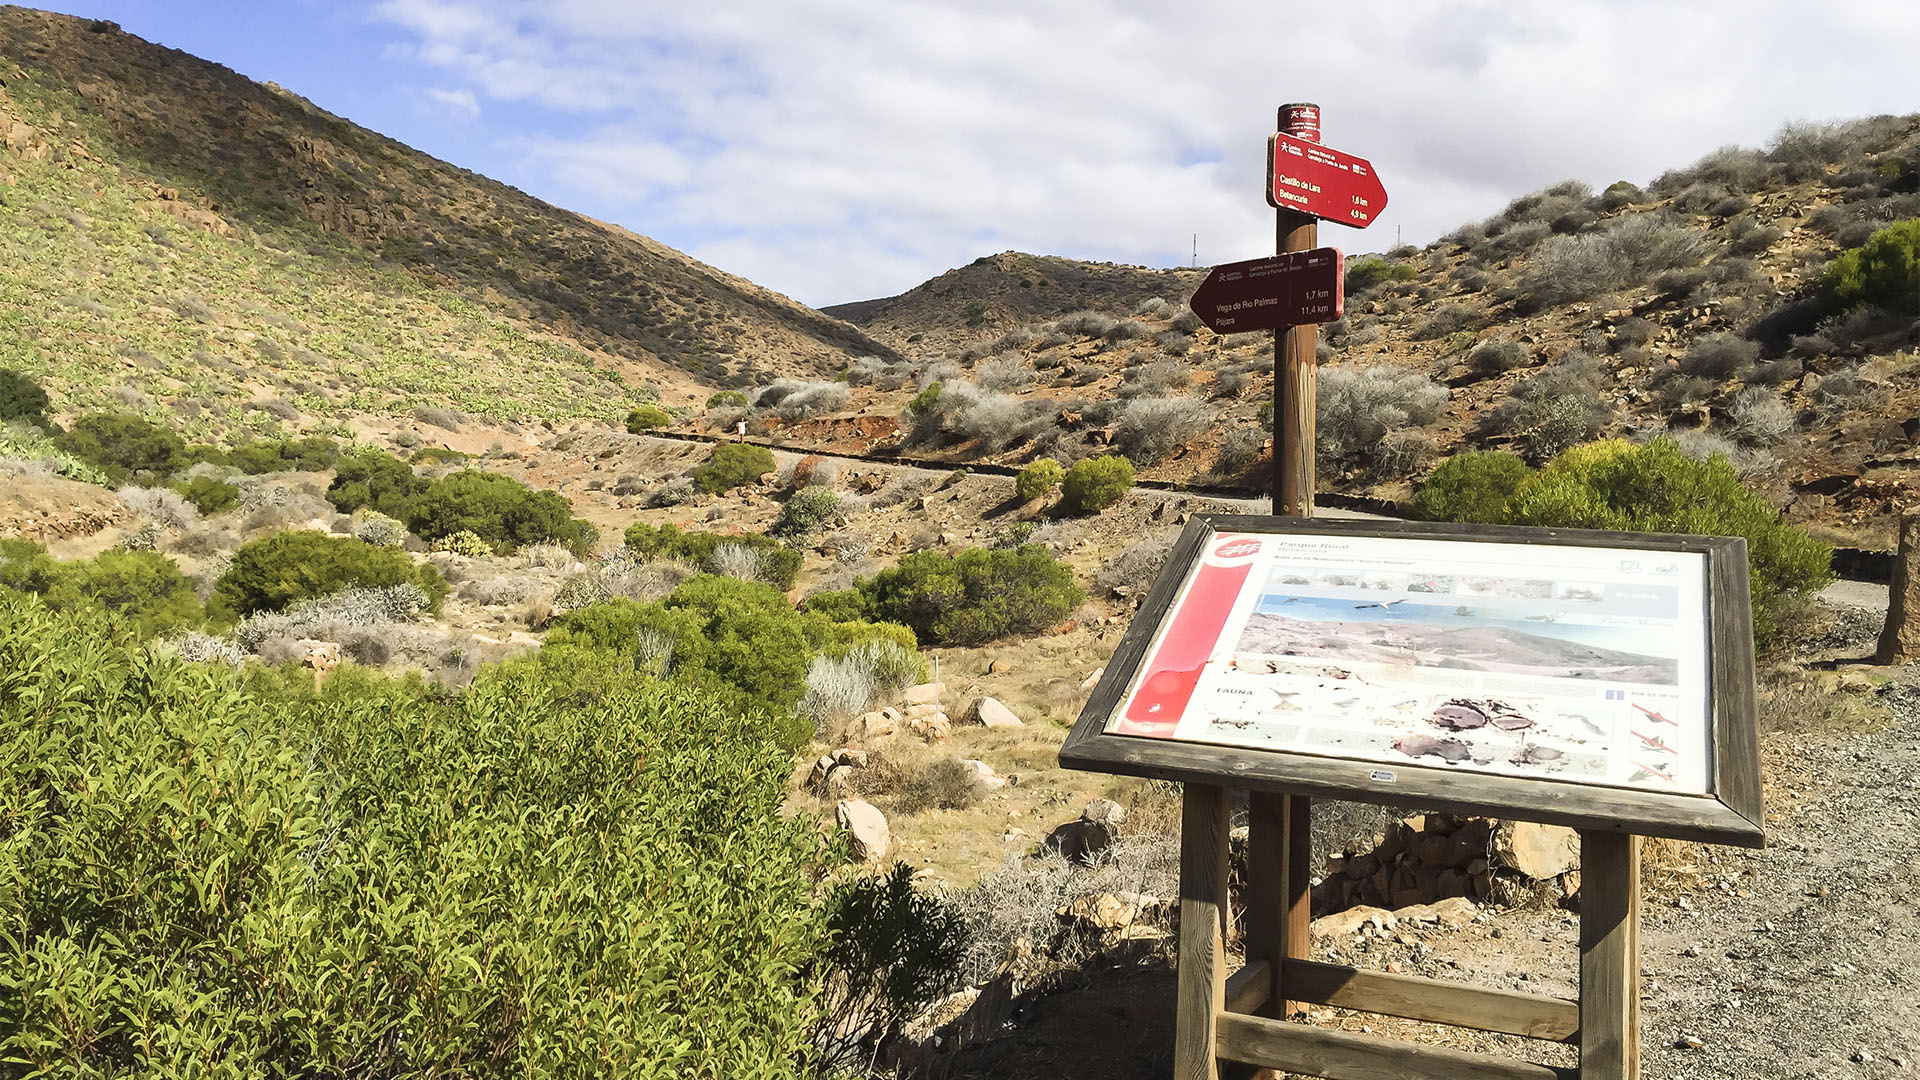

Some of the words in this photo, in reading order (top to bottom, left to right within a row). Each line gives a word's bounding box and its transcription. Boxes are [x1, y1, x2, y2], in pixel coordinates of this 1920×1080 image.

[1279, 174, 1300, 187] Castillo
[1301, 181, 1309, 190] de
[1308, 182, 1321, 194] Lara
[1279, 188, 1308, 204] Betancuria
[1360, 197, 1369, 207] km
[1350, 209, 1360, 219] 4,9
[1359, 211, 1368, 221] km
[1305, 290, 1316, 301] 1,7
[1317, 289, 1329, 298] km
[1216, 303, 1232, 313] Vega
[1232, 302, 1241, 310] de
[1254, 297, 1278, 308] Palmas
[1301, 306, 1316, 316] 11,4
[1317, 304, 1329, 313] km
[1280, 541, 1317, 549] Parque
[1217, 688, 1253, 696] FAUNA
